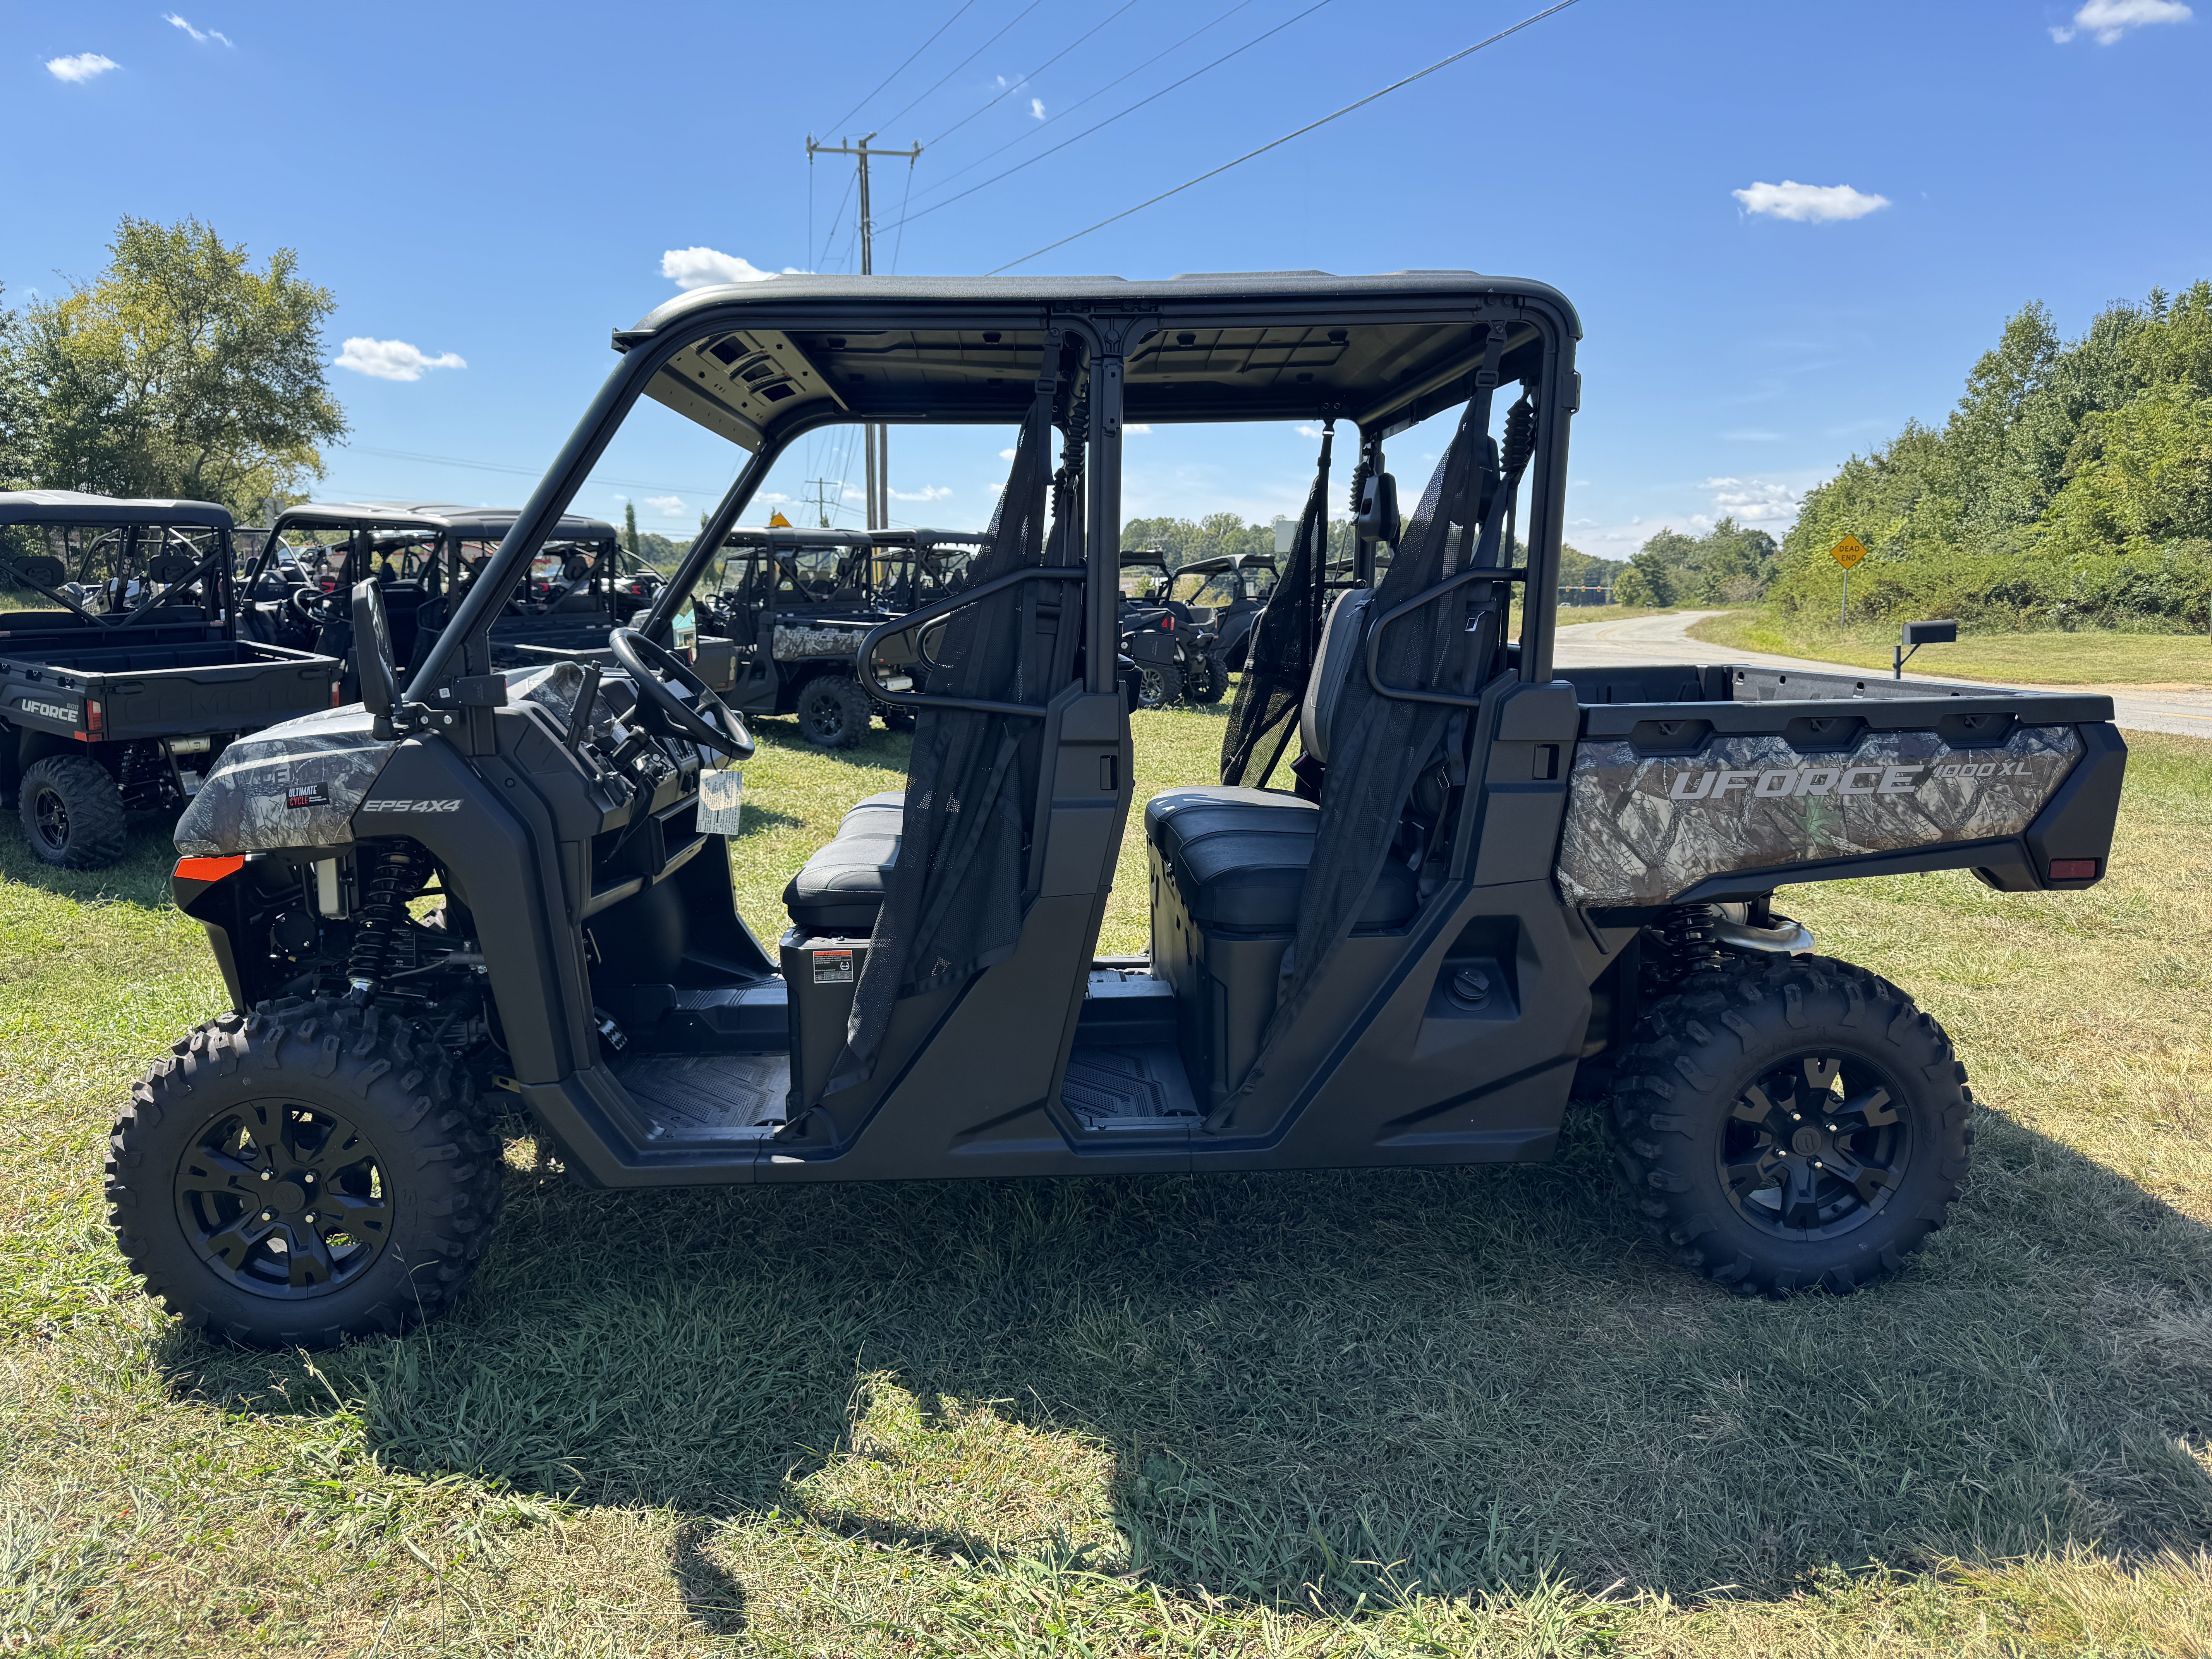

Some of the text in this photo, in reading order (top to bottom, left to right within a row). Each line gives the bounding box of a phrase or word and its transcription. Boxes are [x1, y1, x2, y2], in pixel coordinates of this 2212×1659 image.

[788, 632, 834, 641] UFORCE
[22, 699, 78, 723] UFORCE
[1669, 762, 2032, 800] UFORCE 1000 XL
[289, 785, 318, 798] ULTIMATE
[290, 795, 309, 806] CYCLE
